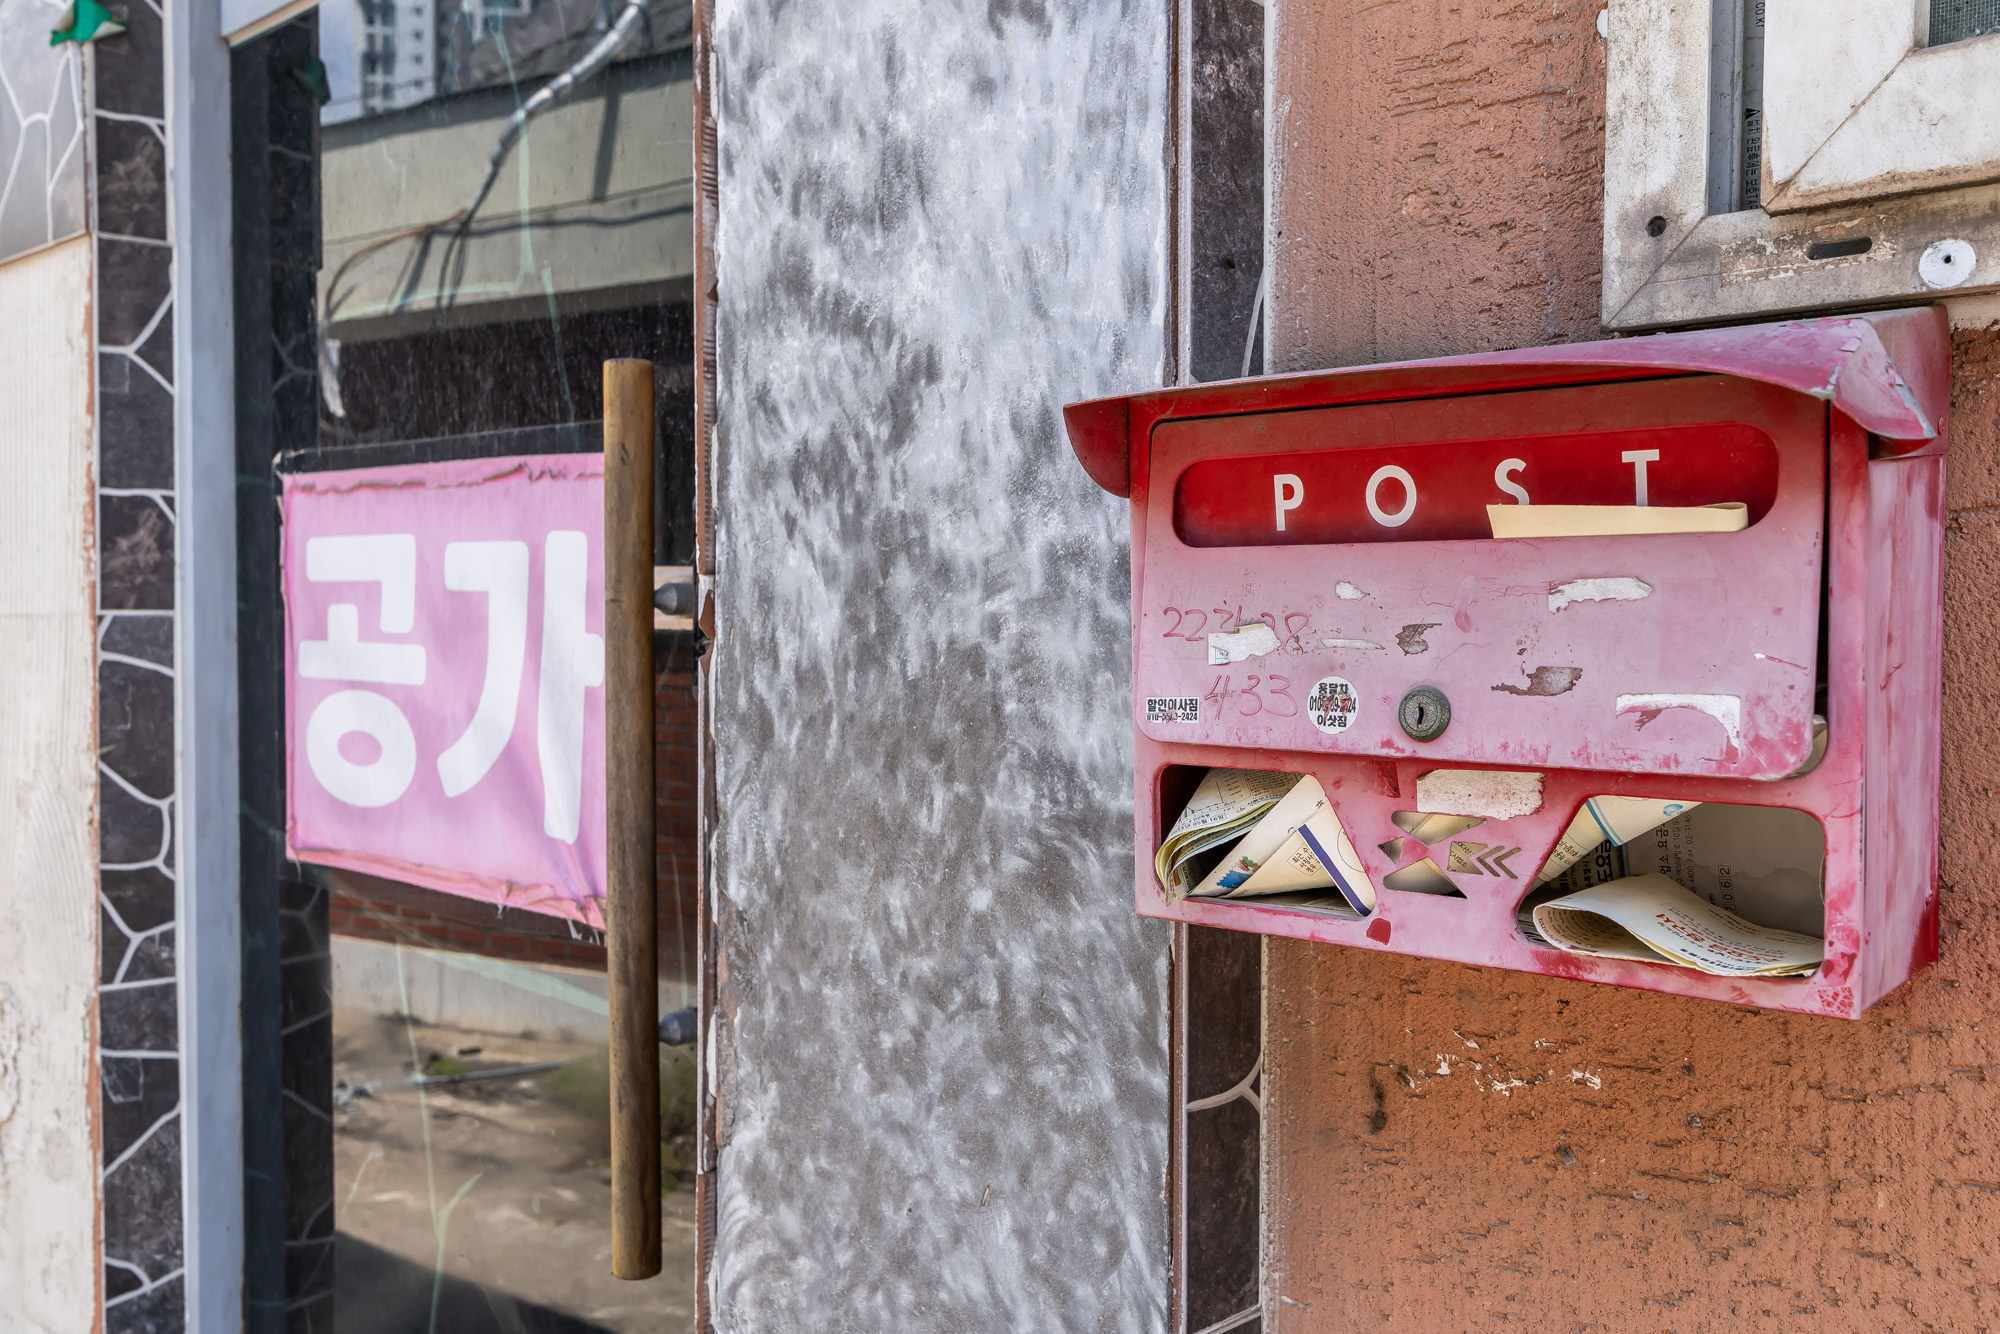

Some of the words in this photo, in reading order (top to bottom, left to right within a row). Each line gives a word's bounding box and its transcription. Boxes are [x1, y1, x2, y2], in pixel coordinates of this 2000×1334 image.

[1746, 119, 1760, 134] 설치
[1273, 449, 1660, 531] POST
[299, 530, 604, 844] 공가
[1318, 682, 1348, 695] 용달차
[1204, 674, 1299, 720] 433
[1147, 698, 1198, 712] 할인이사짐
[1316, 714, 1348, 728] 이삿짐
